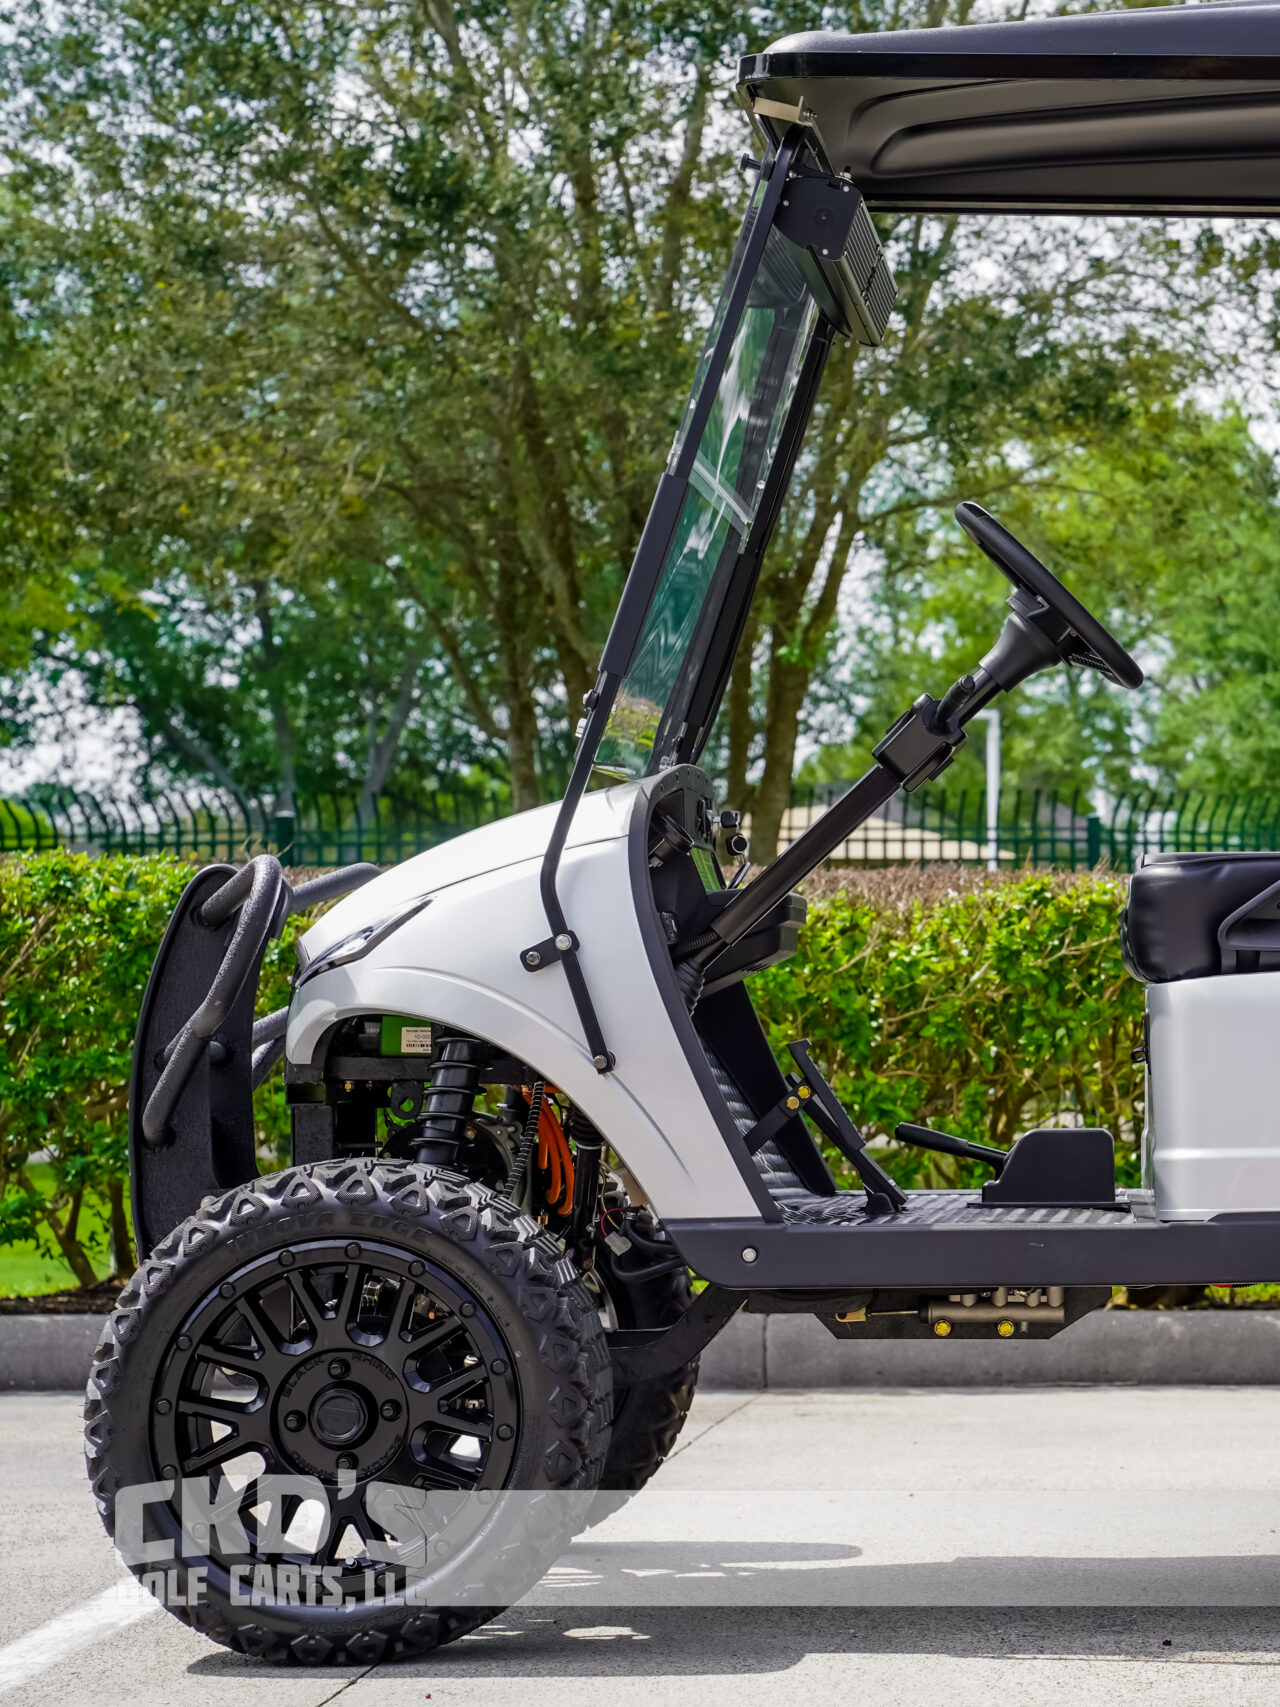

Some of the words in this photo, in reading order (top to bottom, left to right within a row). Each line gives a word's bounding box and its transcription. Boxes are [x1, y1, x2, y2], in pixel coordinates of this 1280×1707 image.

[223, 1211, 335, 1256] INNOVA
[350, 1212, 434, 1245] EDGE
[281, 1356, 326, 1399] BLACK
[351, 1351, 397, 1382] RHINO
